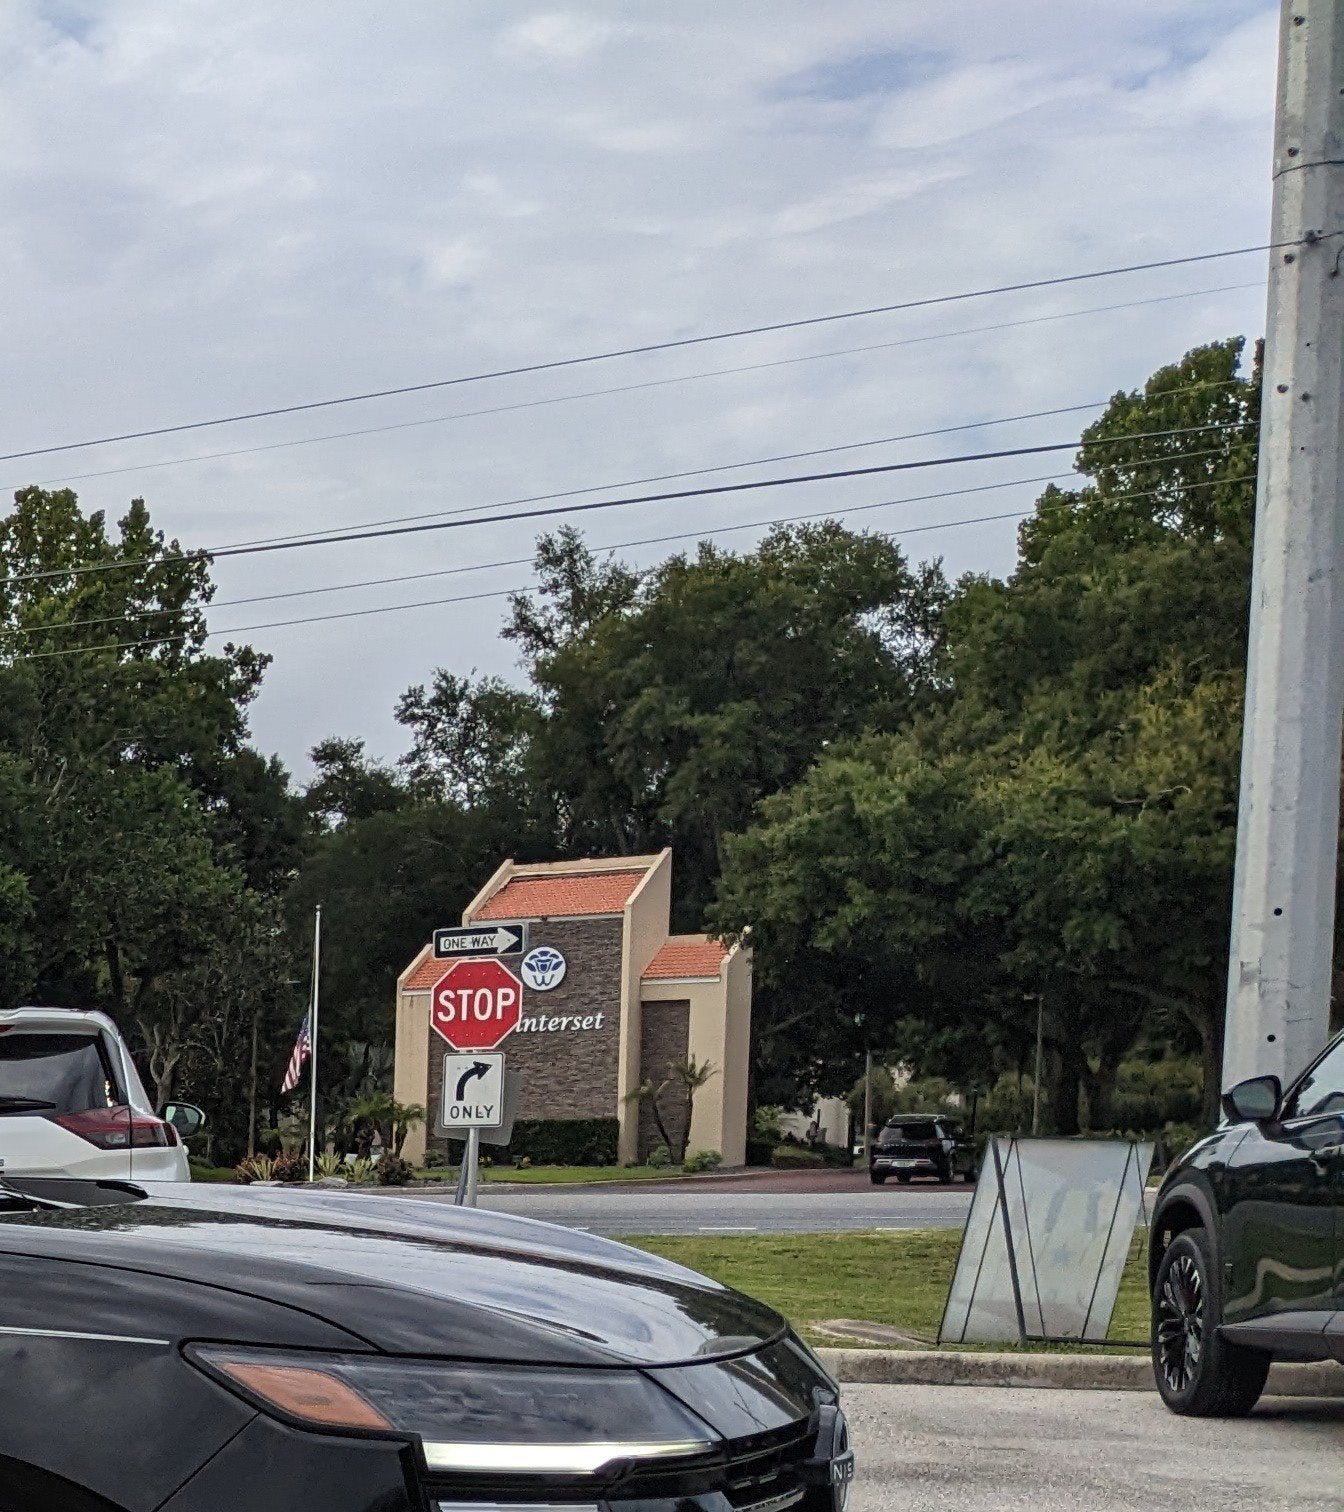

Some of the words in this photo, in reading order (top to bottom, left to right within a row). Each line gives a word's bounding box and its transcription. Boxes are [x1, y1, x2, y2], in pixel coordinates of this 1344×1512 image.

[443, 936, 467, 950] ONE
[471, 934, 496, 948] WAY
[437, 987, 516, 1022] STOP
[515, 1012, 605, 1033] interset
[450, 1105, 494, 1119] ONLY
[833, 1462, 853, 1480] NIS
